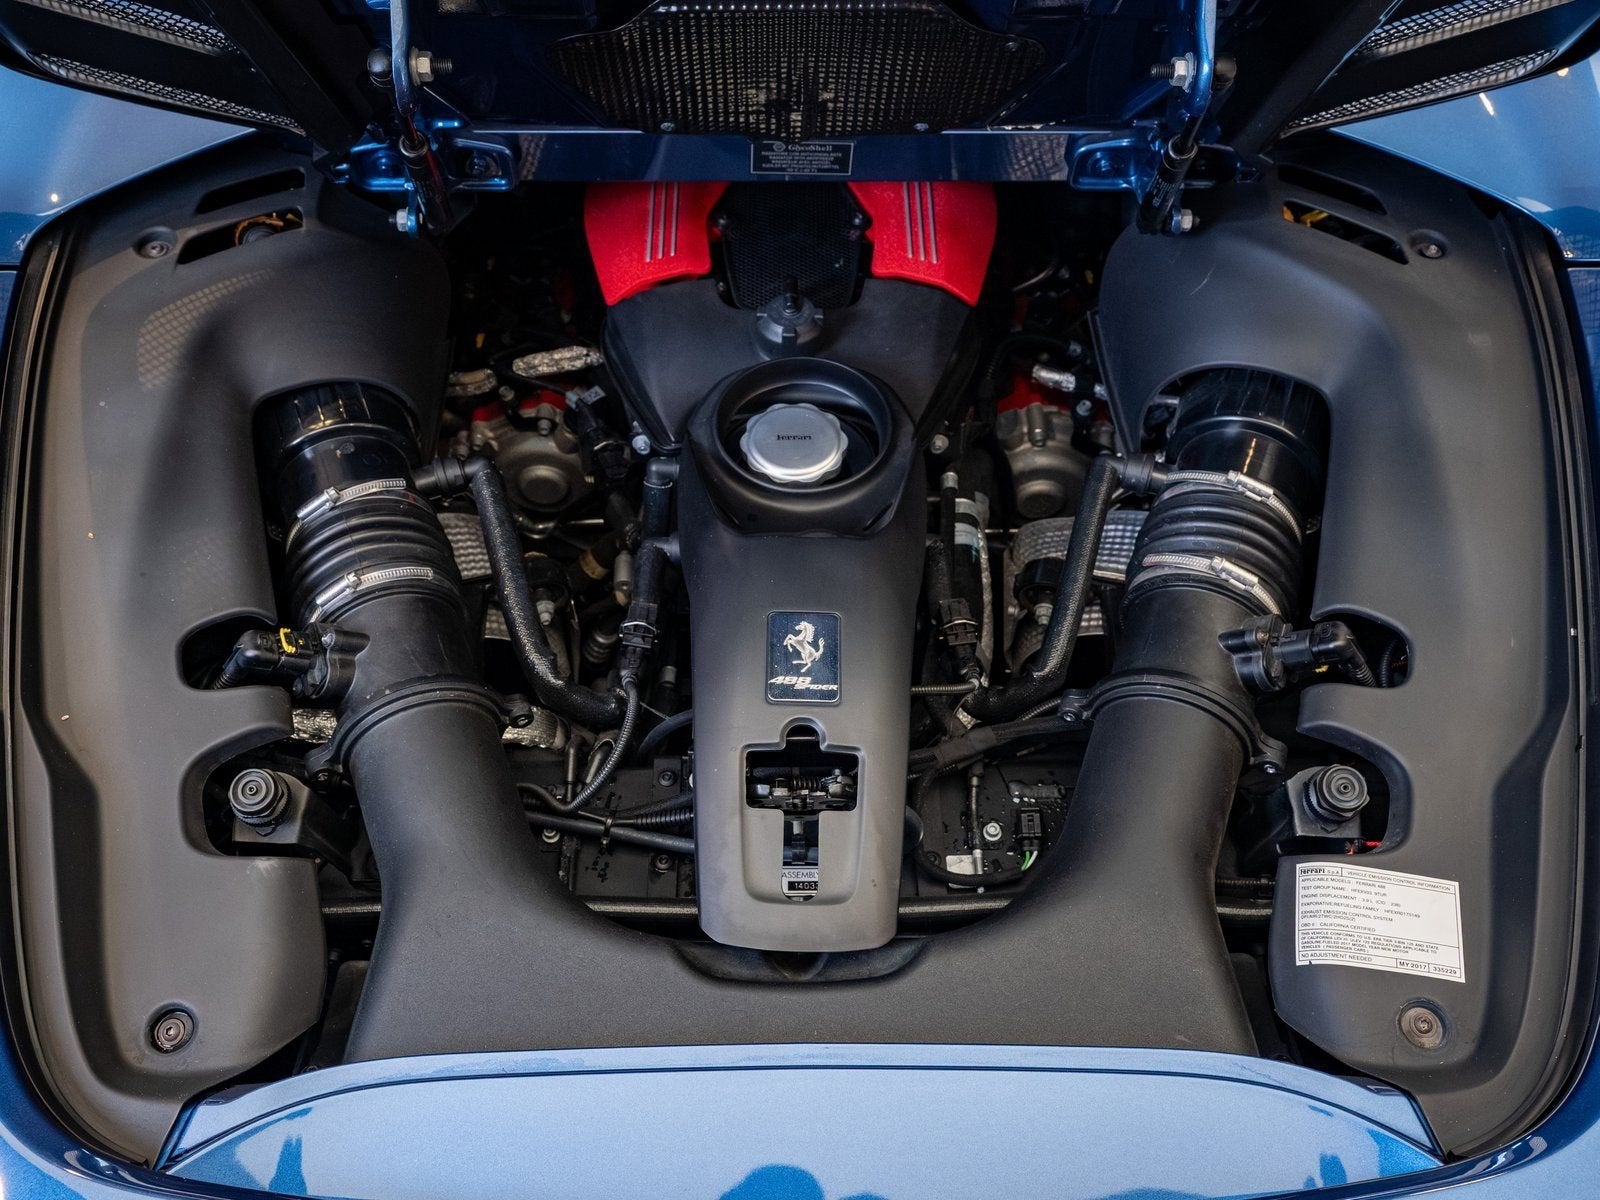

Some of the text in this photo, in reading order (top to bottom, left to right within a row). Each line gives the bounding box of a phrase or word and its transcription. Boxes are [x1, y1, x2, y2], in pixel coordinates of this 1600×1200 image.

[768, 676, 811, 686] 488
[1416, 882, 1450, 891] INFORMATION
[1403, 945, 1429, 953] APPLICABLE
[1349, 954, 1372, 962] NEEDED
